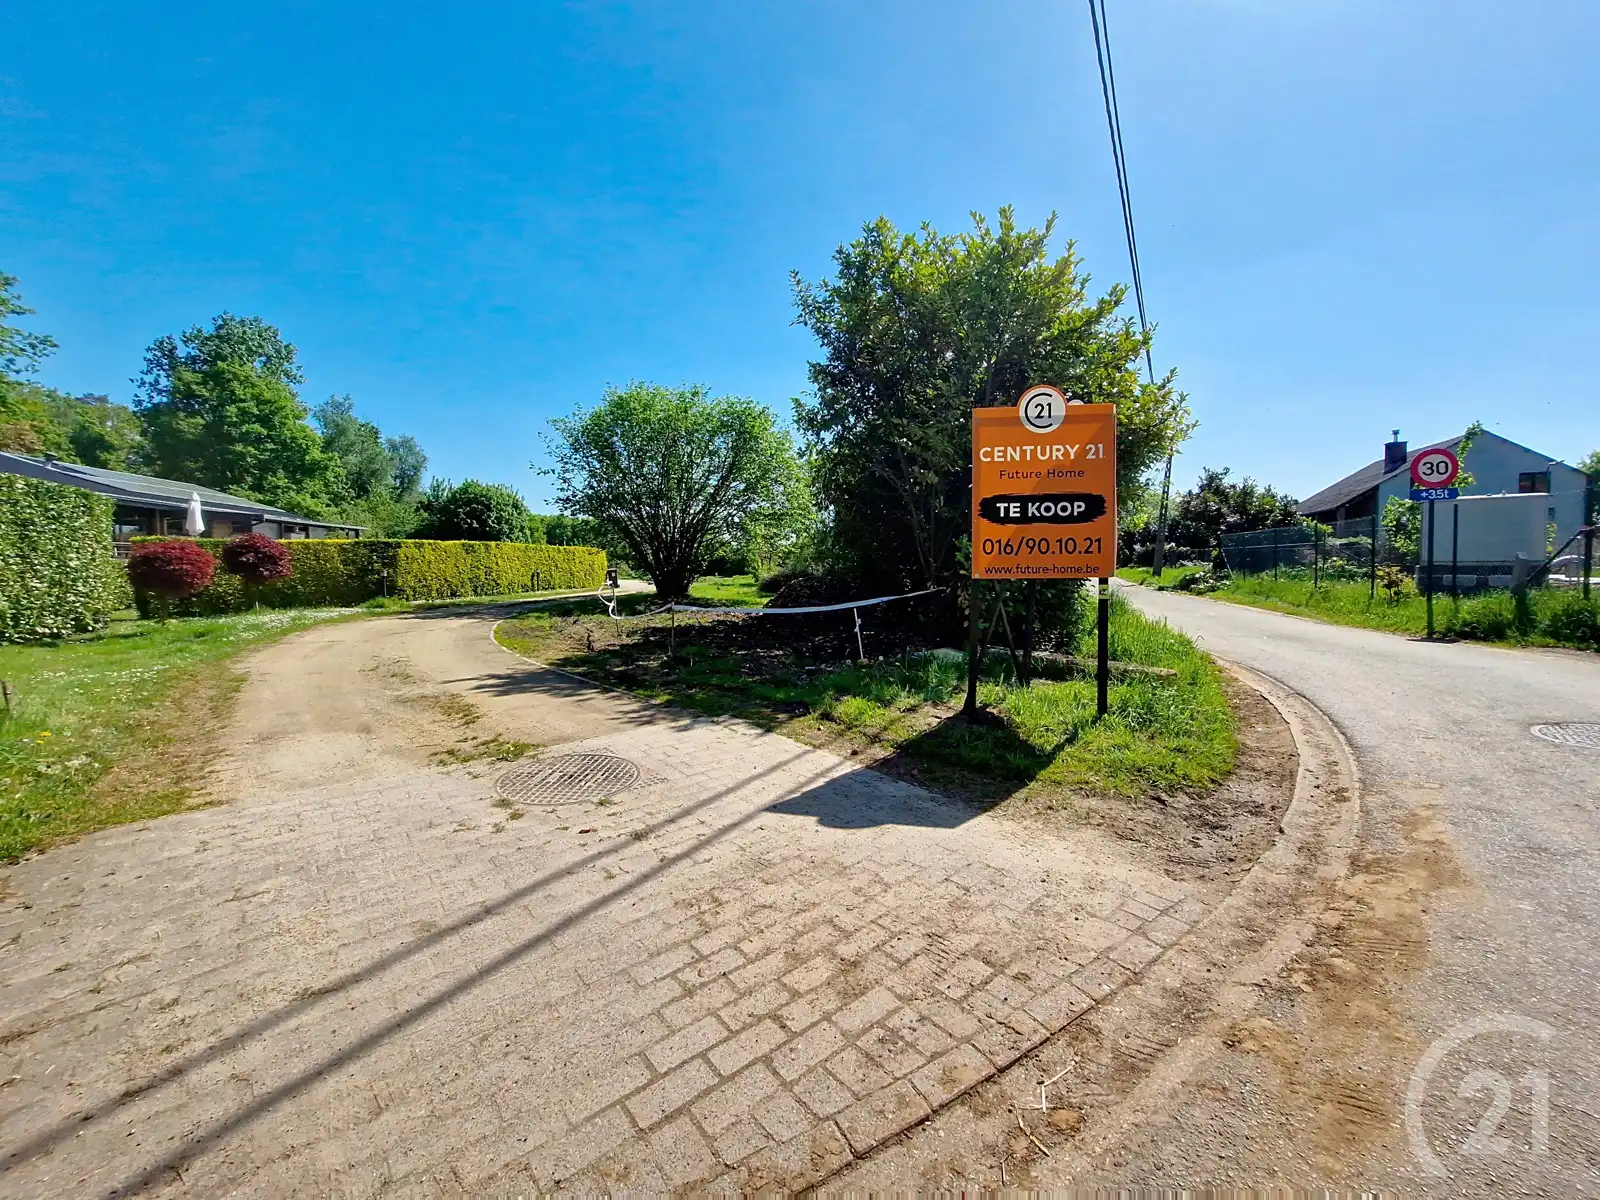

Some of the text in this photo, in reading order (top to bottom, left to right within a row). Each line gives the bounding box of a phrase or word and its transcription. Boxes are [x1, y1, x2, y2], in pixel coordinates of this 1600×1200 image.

[979, 443, 1105, 462] CENTURY 21
[999, 468, 1085, 480] Future Home
[1422, 460, 1449, 476] 30
[996, 501, 1086, 517] TE KOOP
[982, 536, 1103, 557] 016/90.10.21
[984, 563, 1100, 575] www.future-home.be
